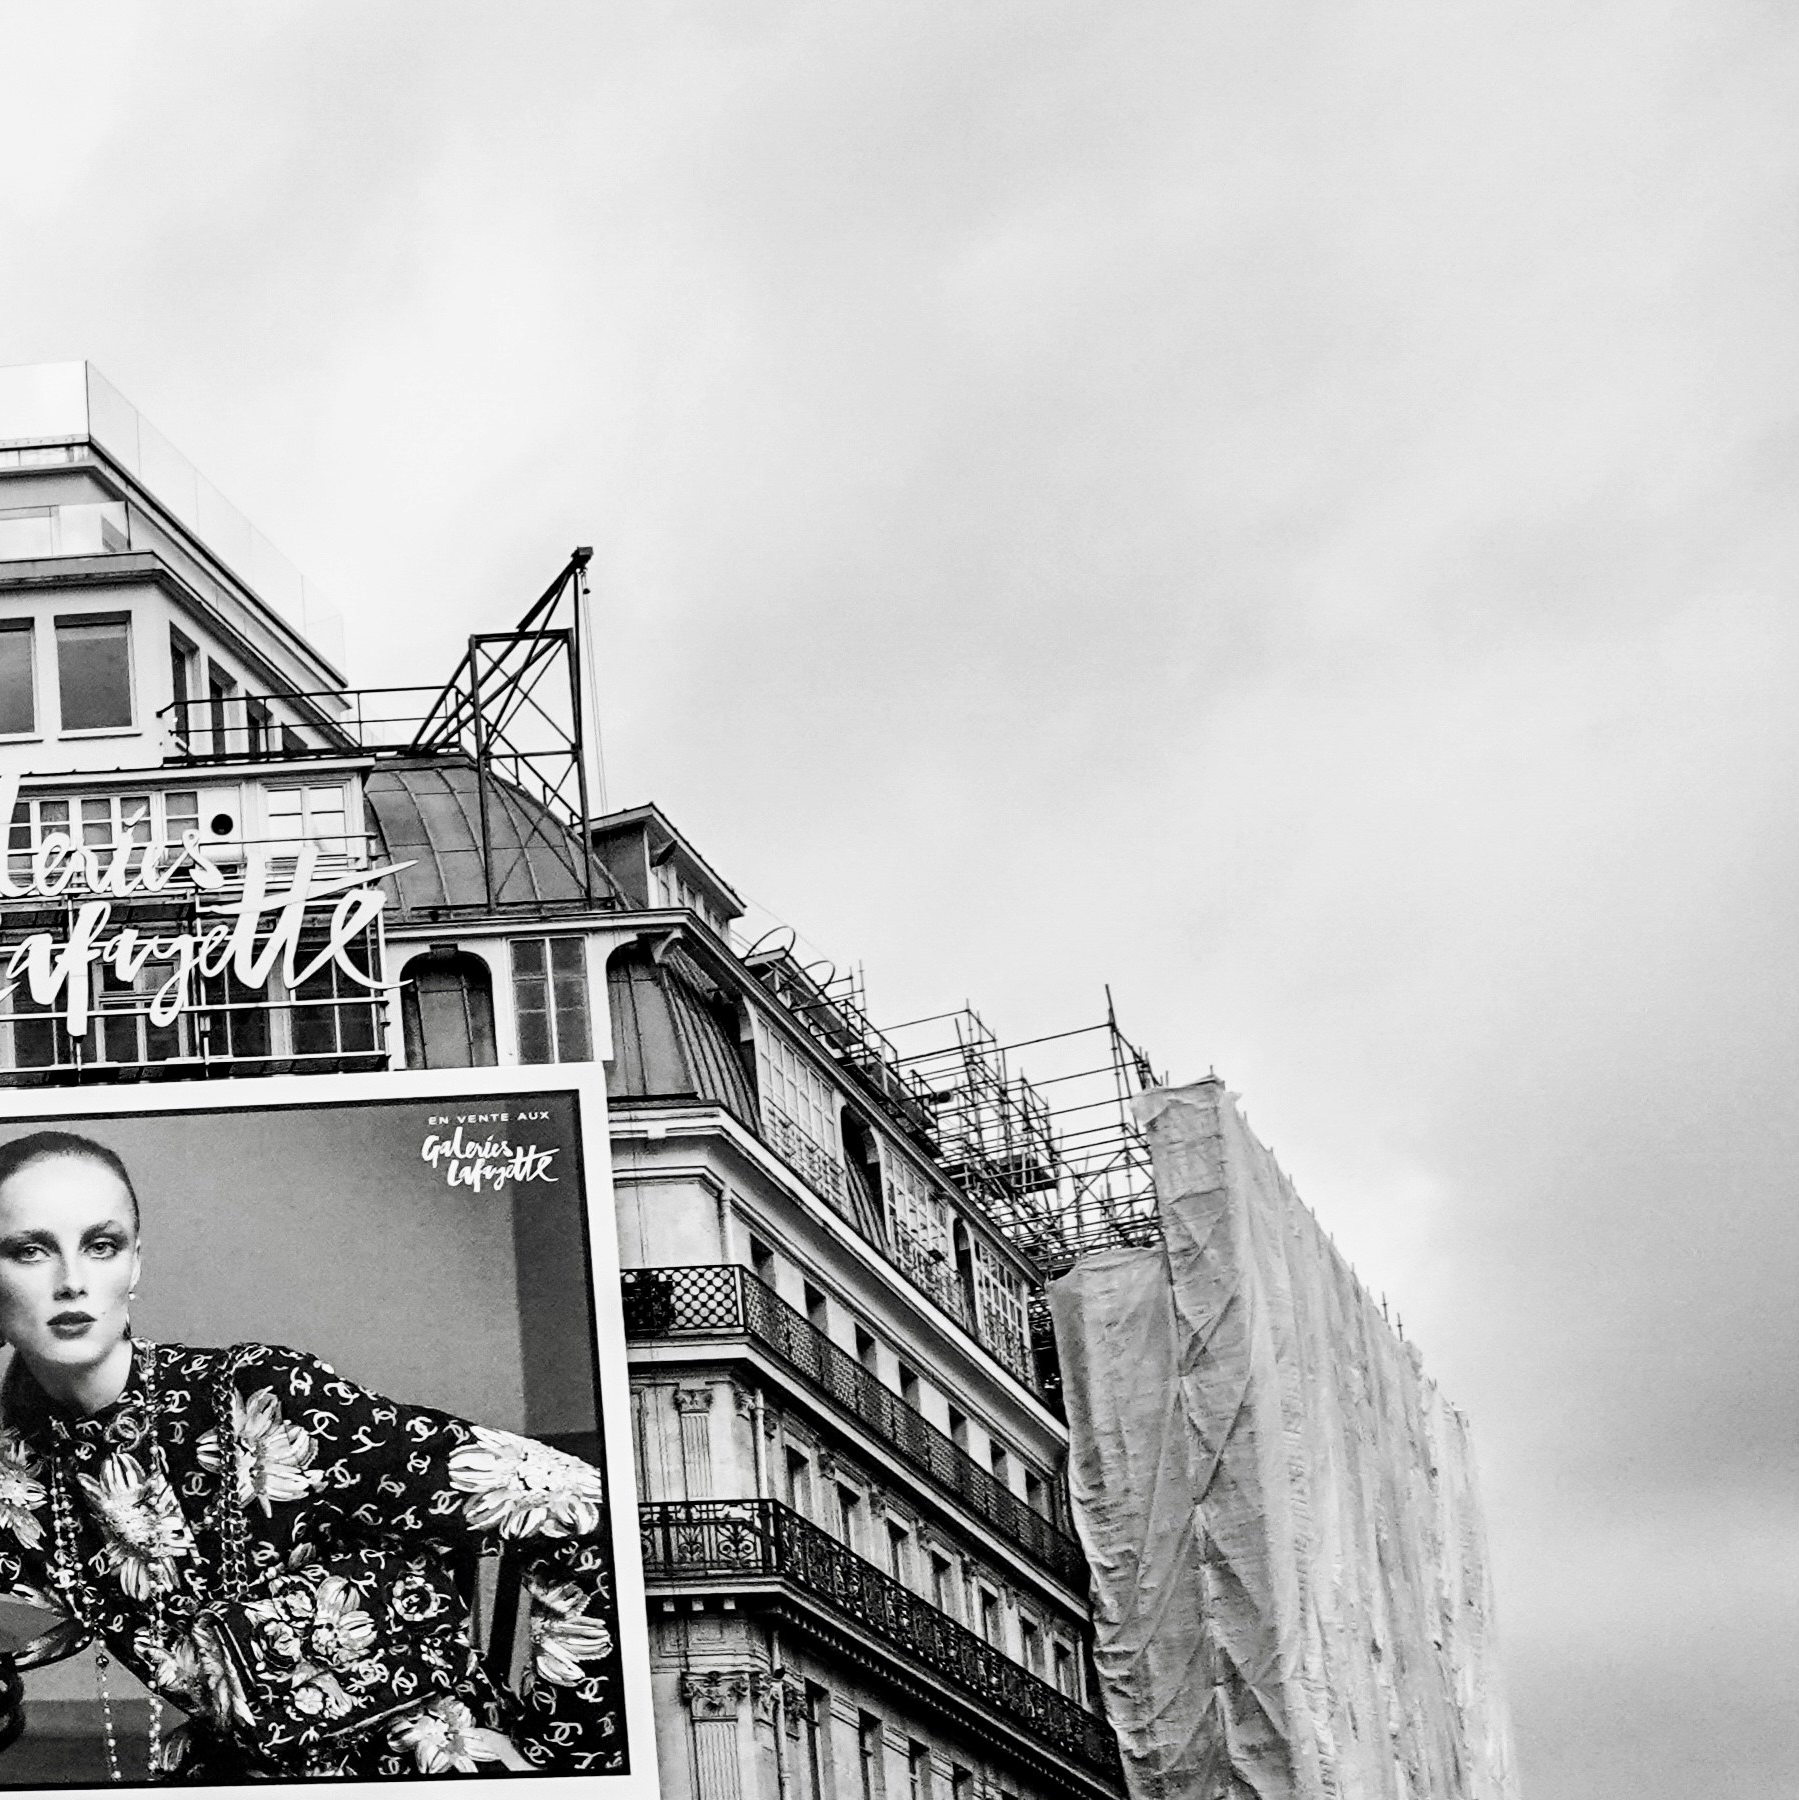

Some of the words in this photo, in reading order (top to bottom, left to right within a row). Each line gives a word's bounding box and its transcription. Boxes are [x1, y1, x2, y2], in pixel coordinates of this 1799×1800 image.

[428, 1116, 448, 1125] EN
[457, 1112, 509, 1124] VENTE
[517, 1111, 550, 1121] AUX
[422, 1126, 514, 1168] Galeries
[447, 1145, 560, 1192] Lafayette
